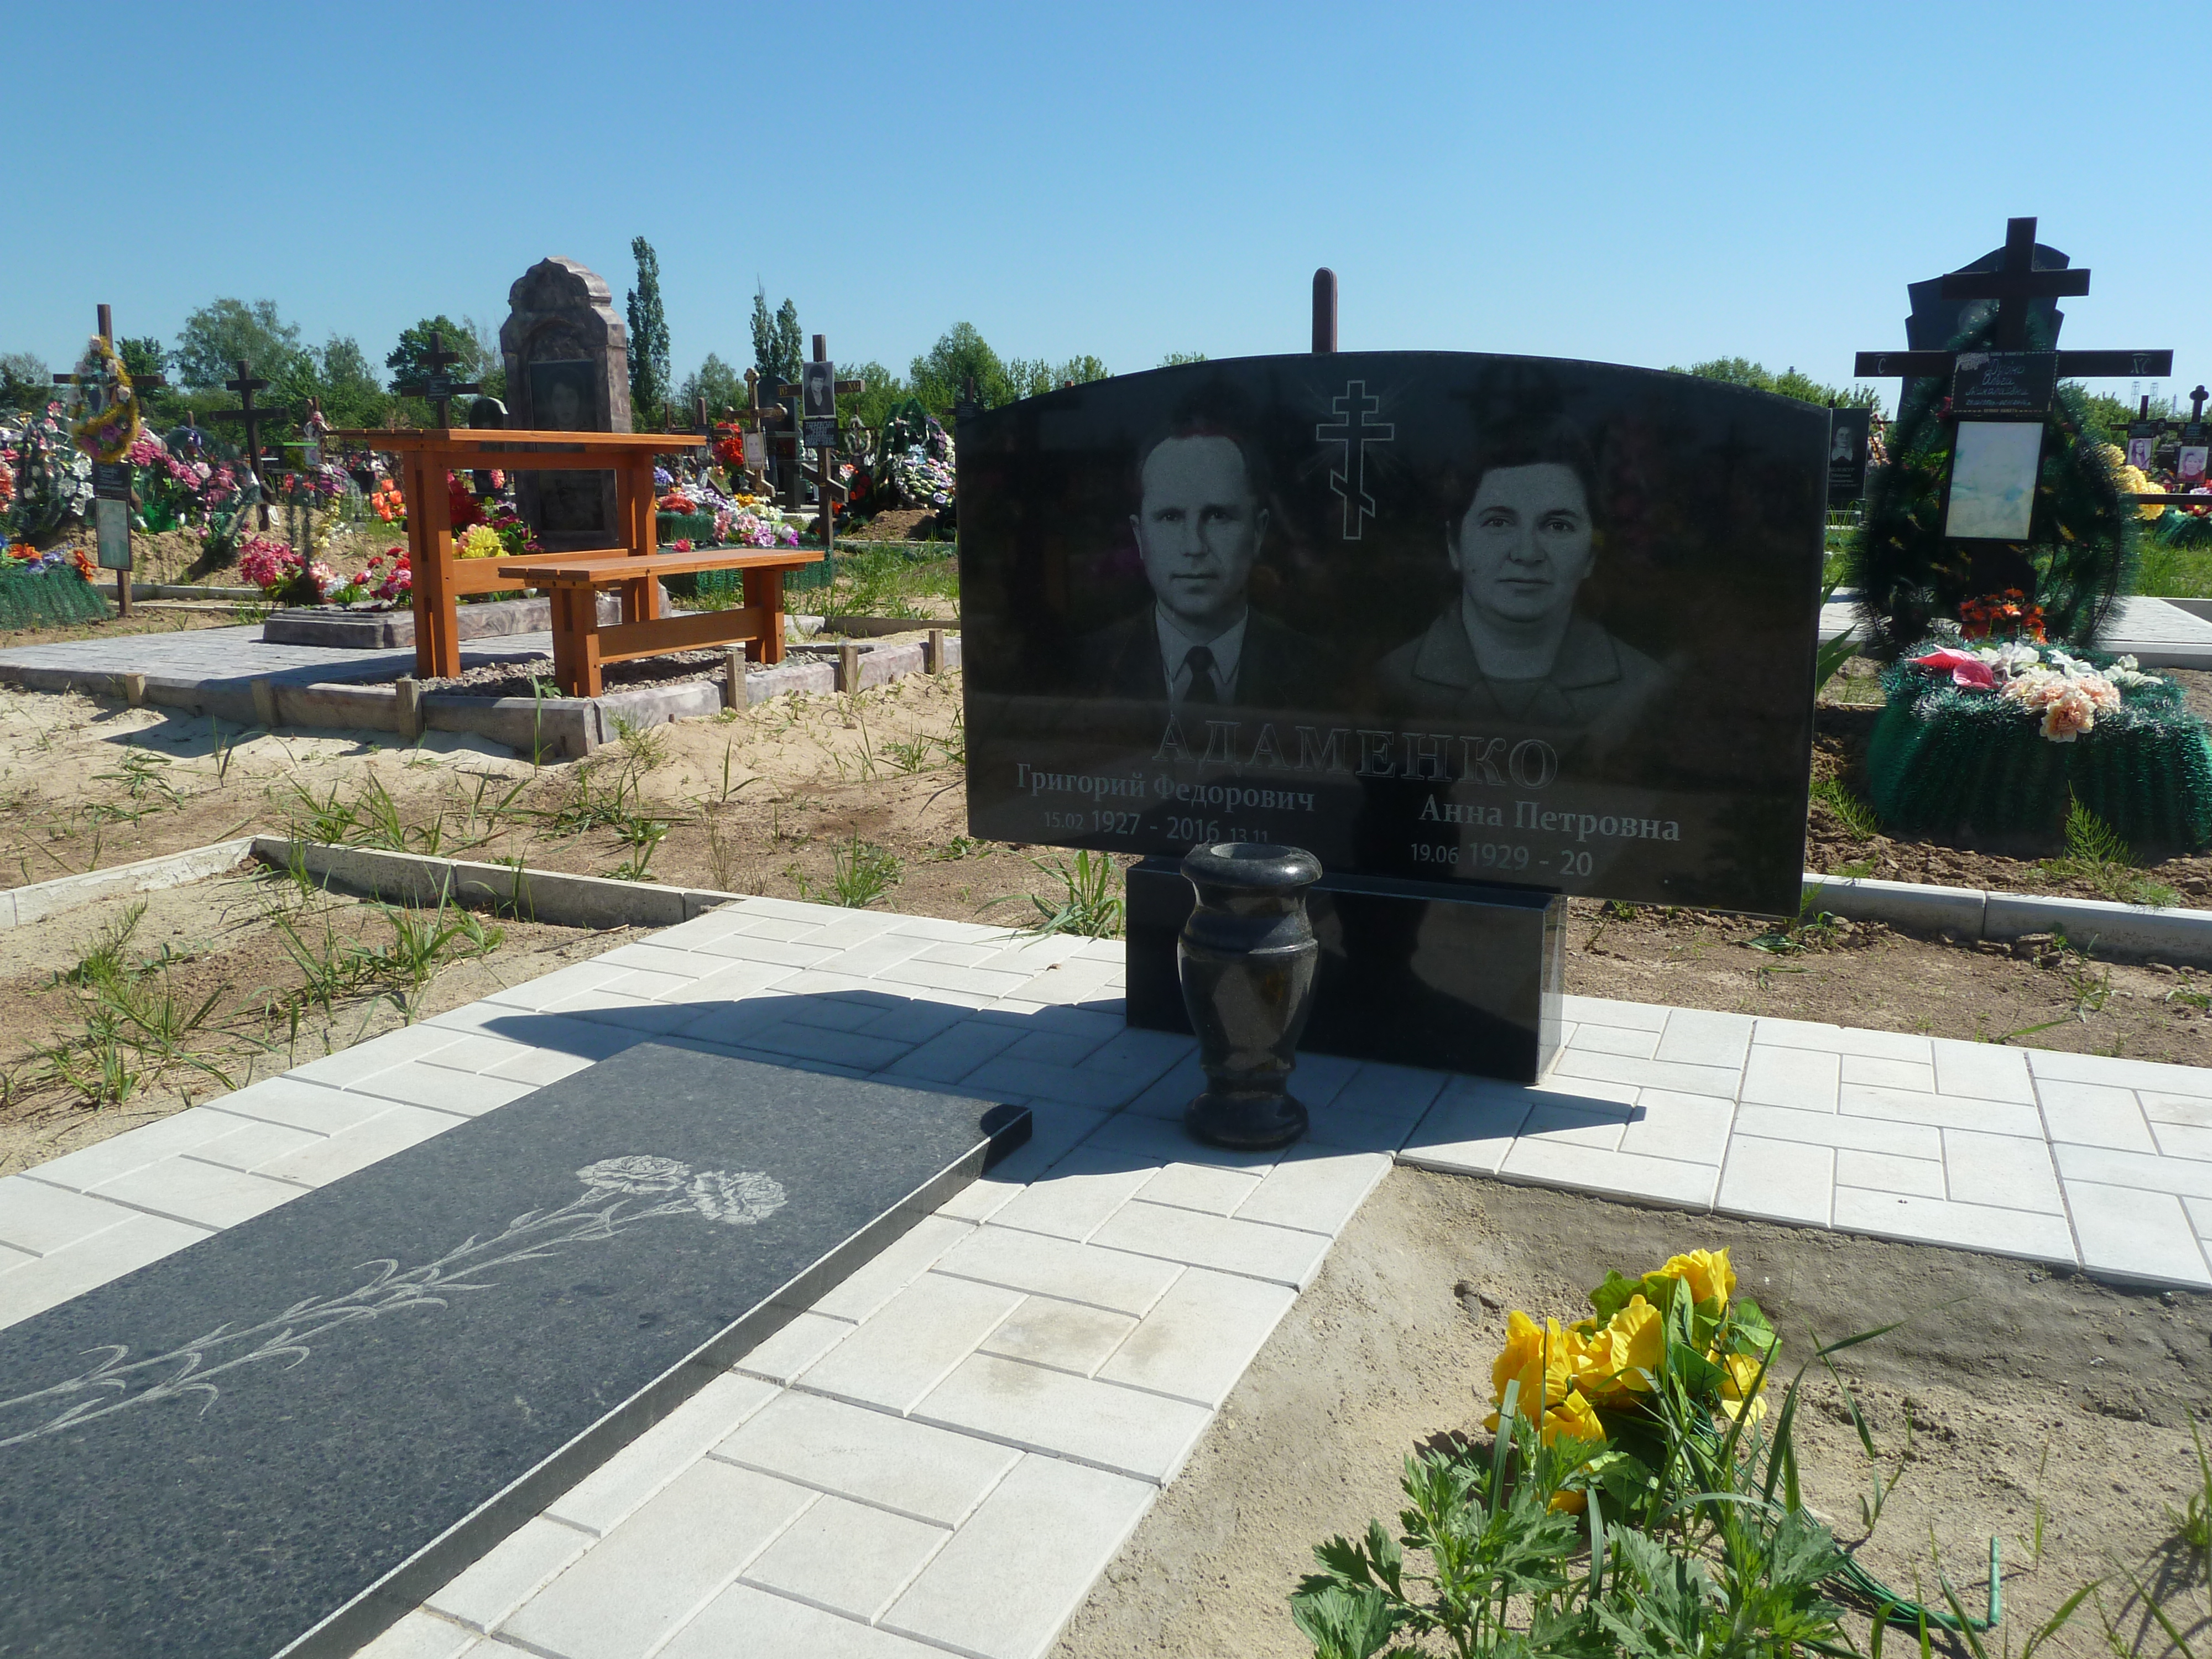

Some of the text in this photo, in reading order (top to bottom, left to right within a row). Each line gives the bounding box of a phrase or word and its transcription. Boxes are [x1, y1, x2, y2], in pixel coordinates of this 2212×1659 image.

[1152, 713, 1558, 790] АДАМЕНКО
[1016, 763, 1315, 813] Григорий Федорович
[1045, 811, 1084, 829] 15.02
[1092, 810, 1141, 835] 1927
[1166, 816, 1220, 842] 2016
[1418, 794, 1681, 842] Анна Петровна
[1411, 843, 1459, 864] 19.06
[1469, 842, 1529, 870] 1929
[1559, 849, 1593, 877] 20
